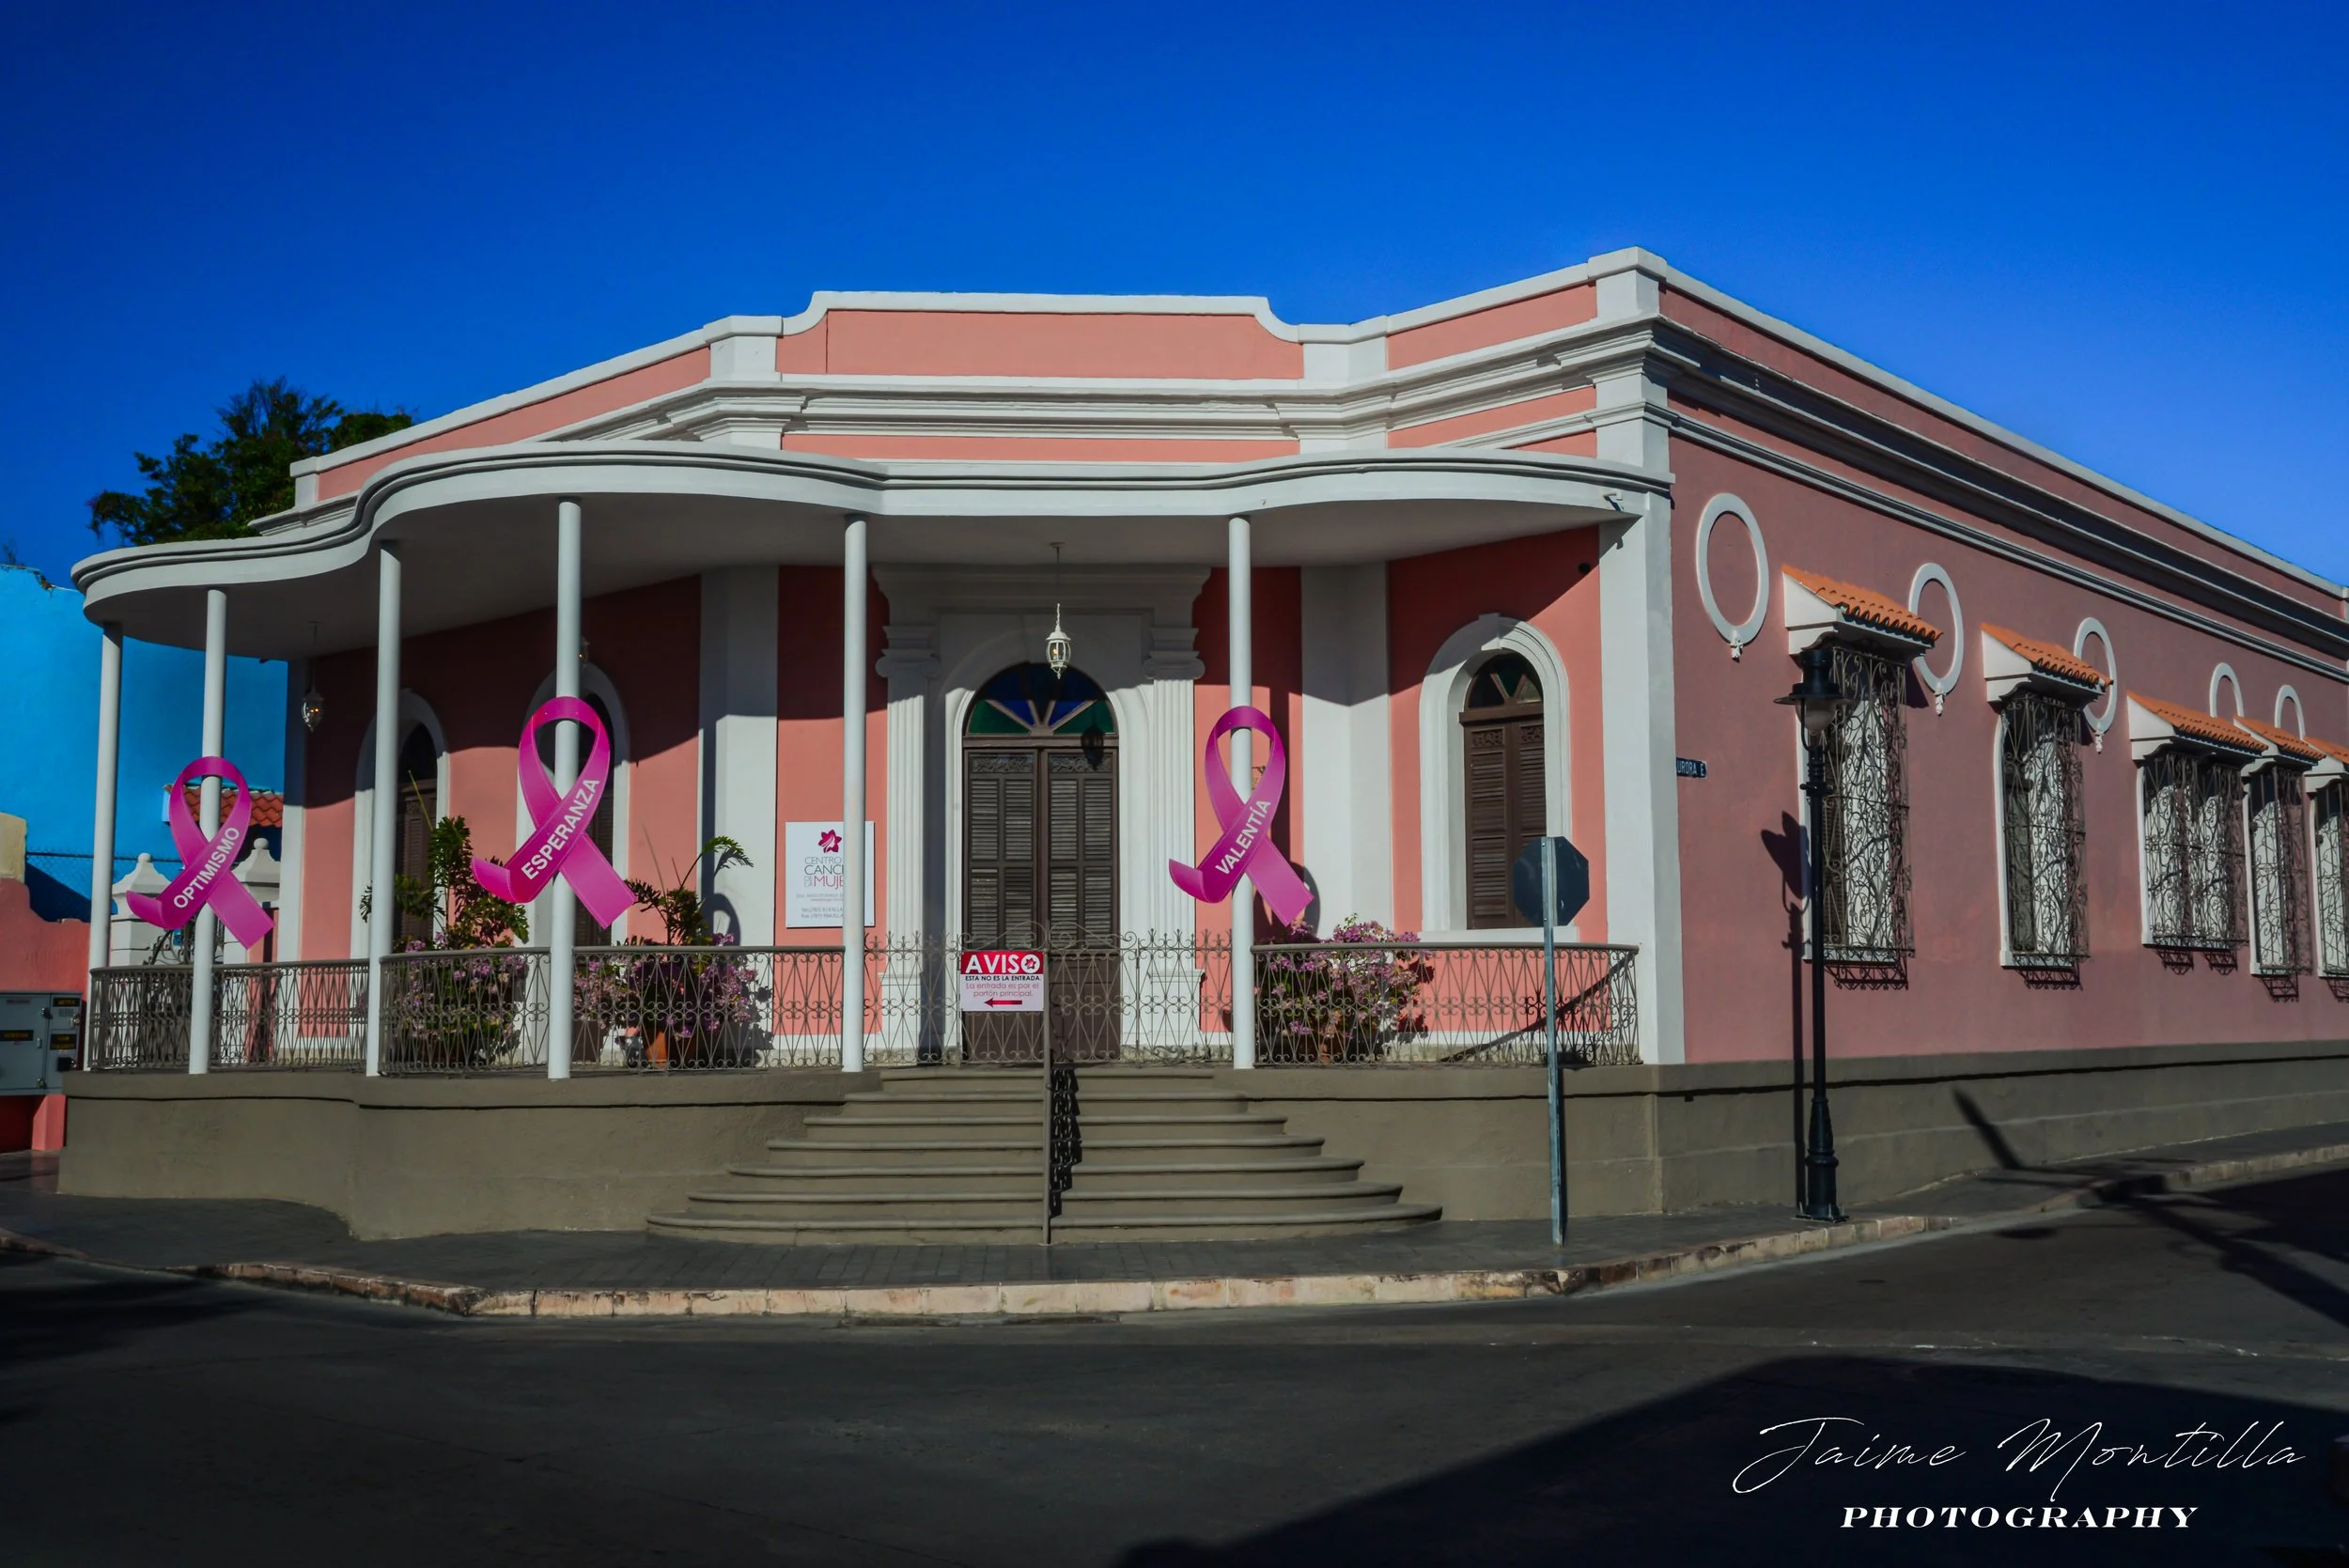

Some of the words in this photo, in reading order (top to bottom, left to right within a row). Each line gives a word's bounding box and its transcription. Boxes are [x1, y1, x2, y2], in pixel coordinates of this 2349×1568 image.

[521, 780, 600, 880] ESPERANZA
[804, 856, 842, 865] CENTRO
[1214, 800, 1271, 875] VALENTÍA
[173, 828, 240, 908] OPTIMISMO
[965, 954, 1040, 974] AVISO
